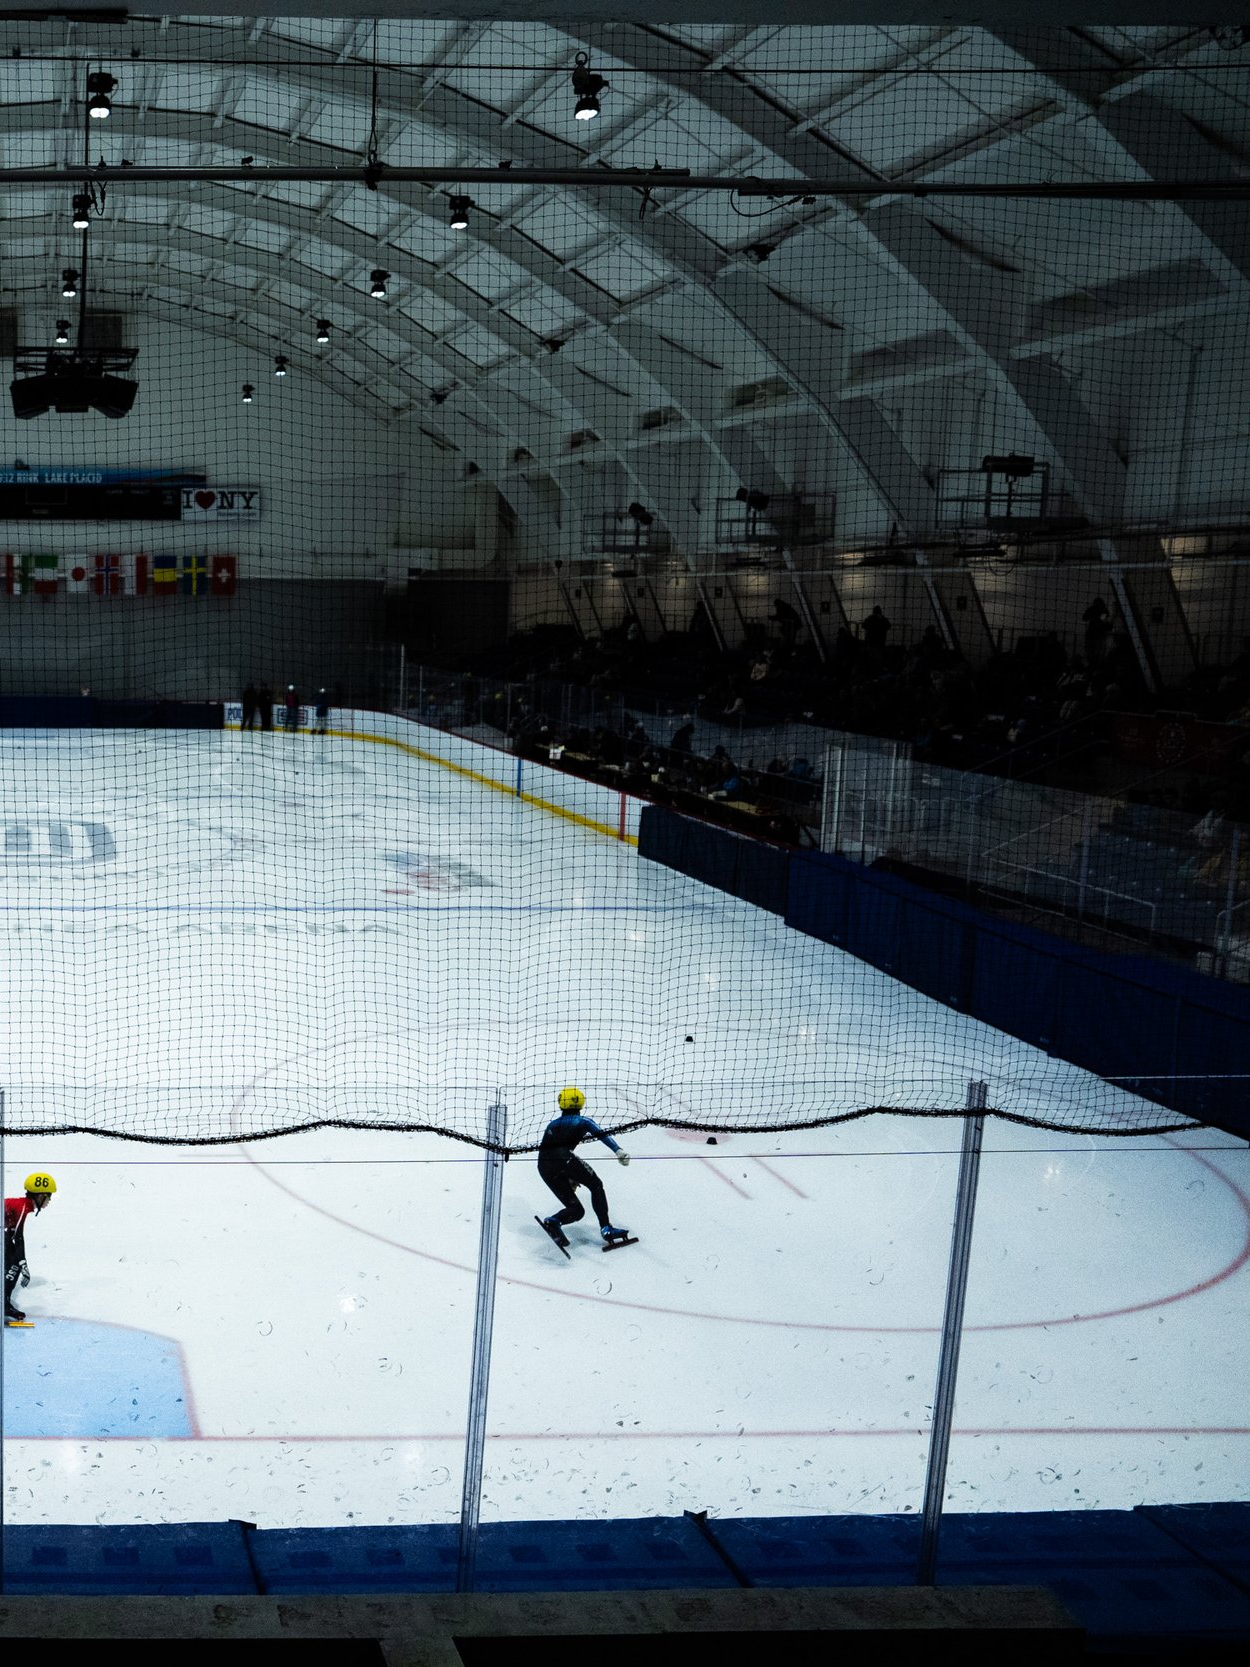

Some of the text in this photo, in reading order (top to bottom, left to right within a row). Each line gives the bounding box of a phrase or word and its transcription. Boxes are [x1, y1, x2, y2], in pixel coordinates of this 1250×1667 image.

[17, 473, 39, 483] RINK
[45, 473, 70, 483] LAKE
[183, 490, 193, 509] I
[217, 490, 258, 509] NY
[34, 1176, 49, 1188] 86
